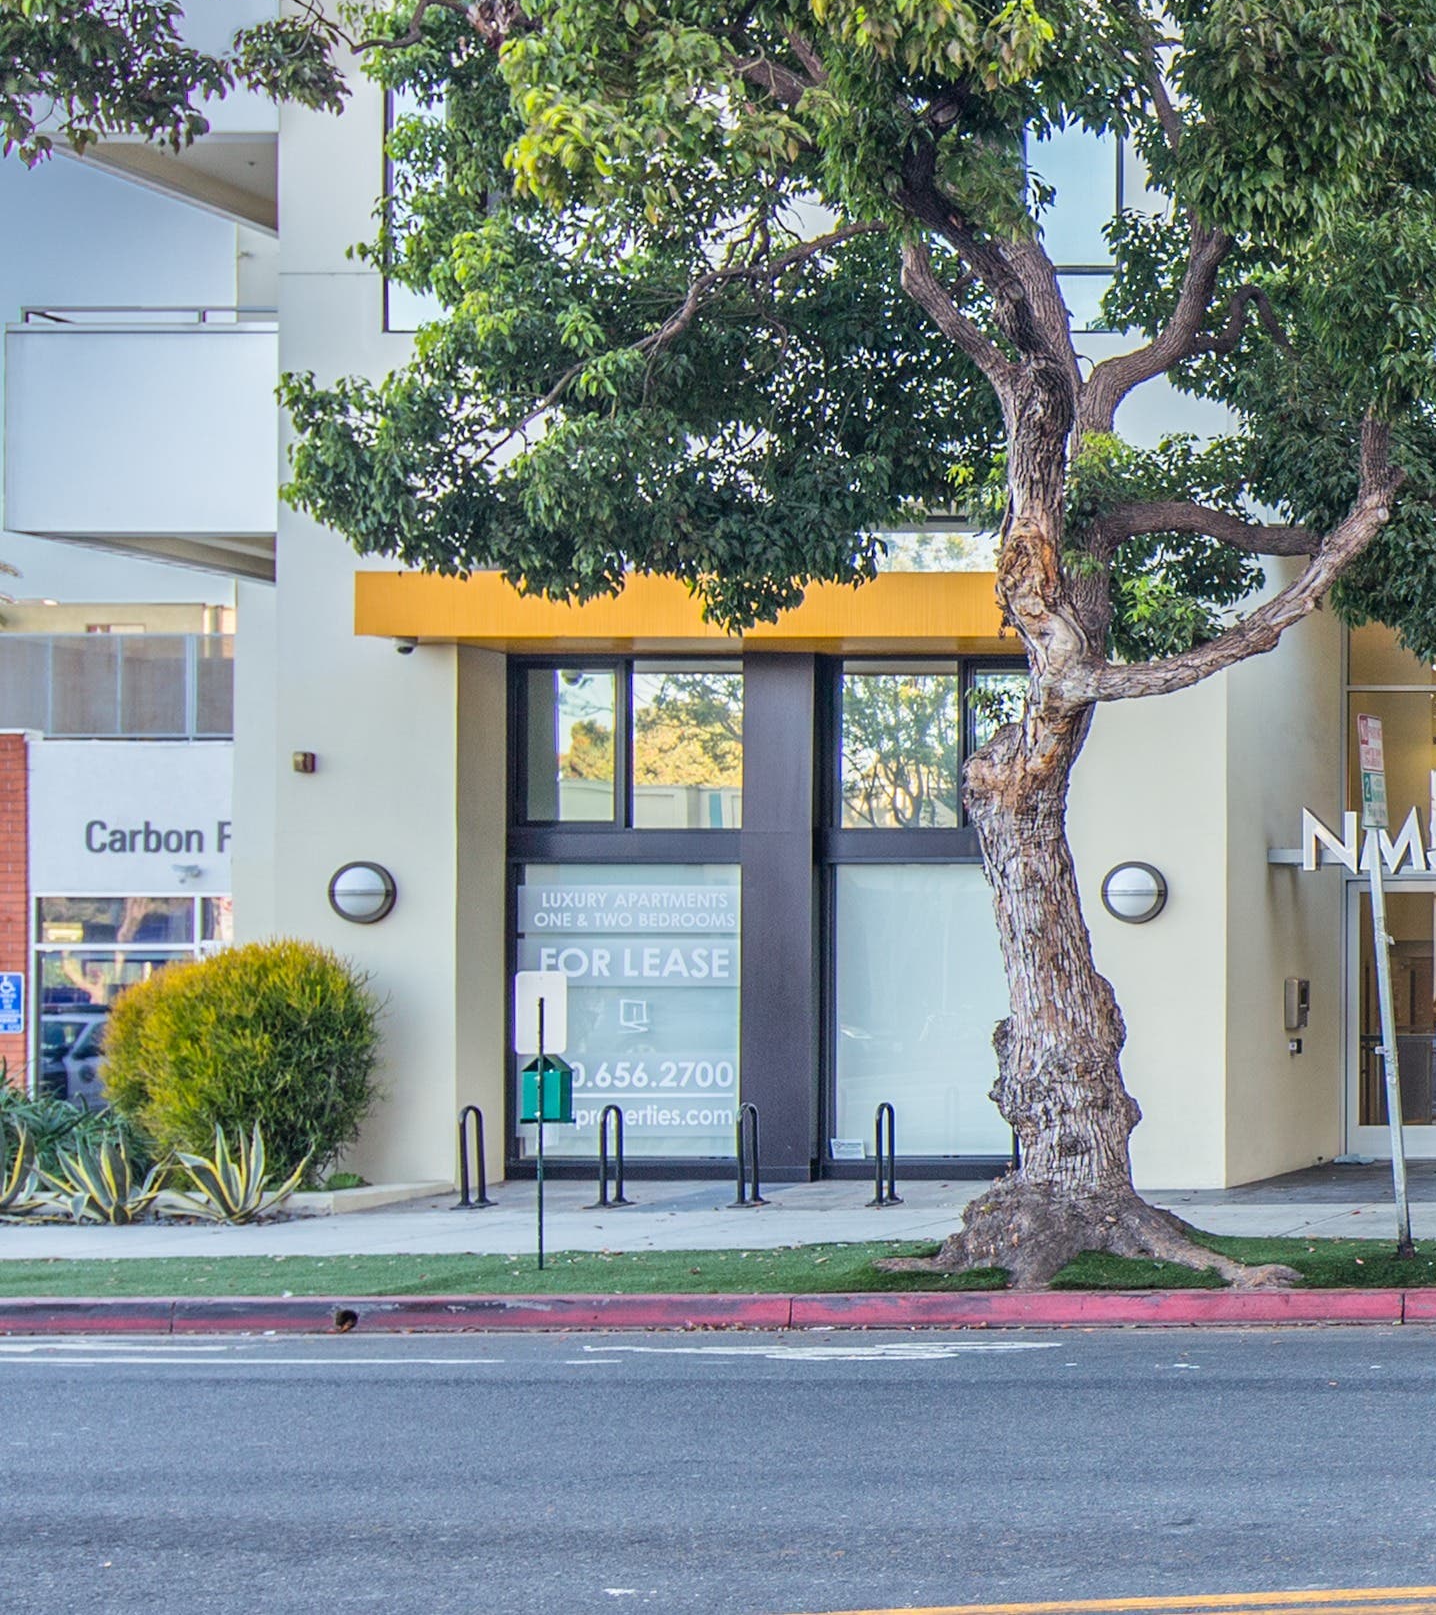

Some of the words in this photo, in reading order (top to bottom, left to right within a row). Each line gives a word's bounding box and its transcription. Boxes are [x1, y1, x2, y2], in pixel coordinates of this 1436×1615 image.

[85, 820, 203, 853] Carbon
[541, 892, 607, 908] LUXURY
[614, 892, 729, 908] APARTMENTS
[534, 912, 572, 927] ONE
[576, 912, 588, 927] &
[594, 912, 633, 927] TWO
[639, 912, 736, 928] BEDROOMS
[540, 947, 611, 978] FOR
[623, 947, 730, 979] LEASE
